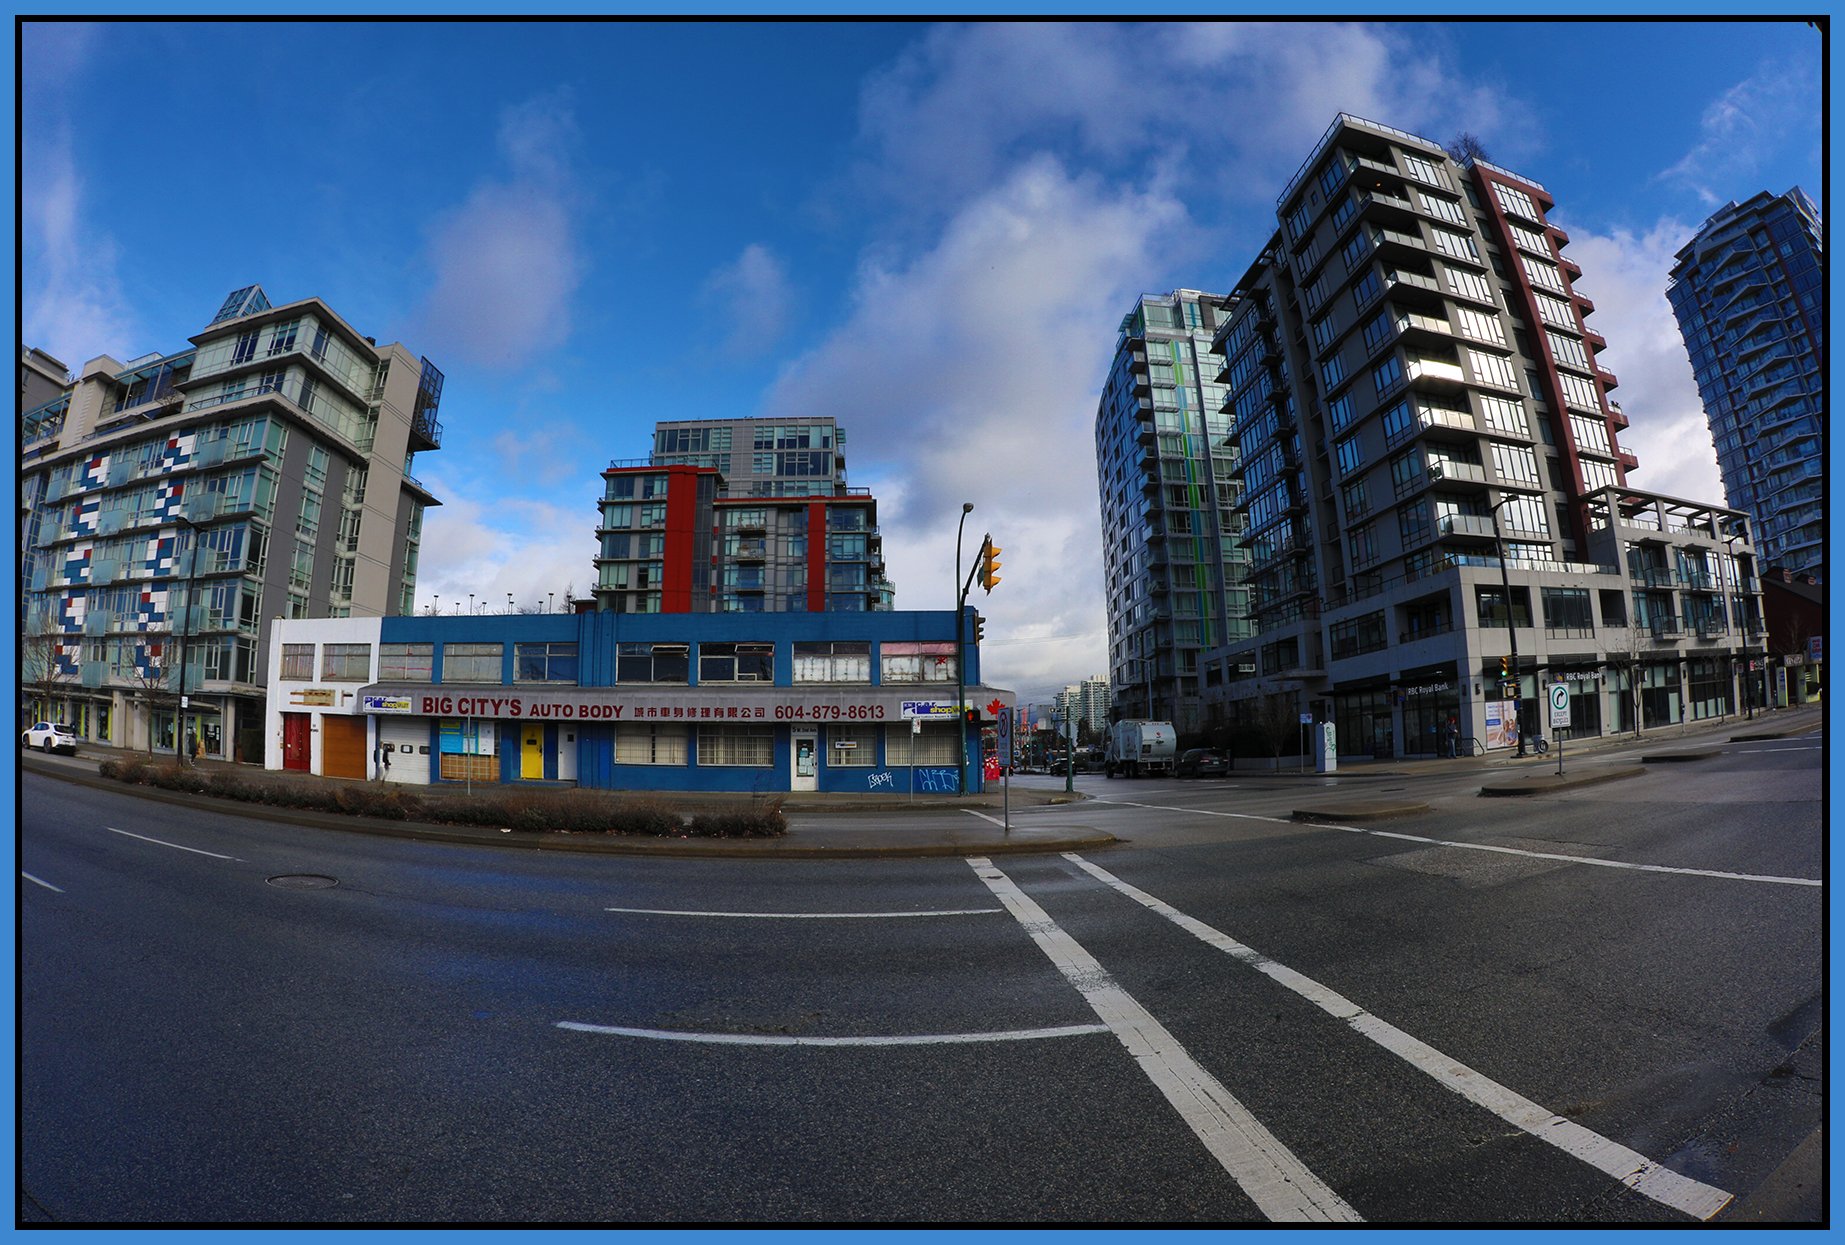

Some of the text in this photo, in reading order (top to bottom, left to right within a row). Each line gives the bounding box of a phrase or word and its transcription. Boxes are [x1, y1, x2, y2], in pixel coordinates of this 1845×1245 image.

[1566, 672, 1576, 681] RBC
[1577, 672, 1590, 682] Royal
[1408, 682, 1449, 696] RBC Royal Bank
[422, 696, 624, 719] BIG CITY'S AUTO BODY
[634, 706, 766, 719] 城市車身修理有限公司
[774, 704, 885, 720] 604-879-8613
